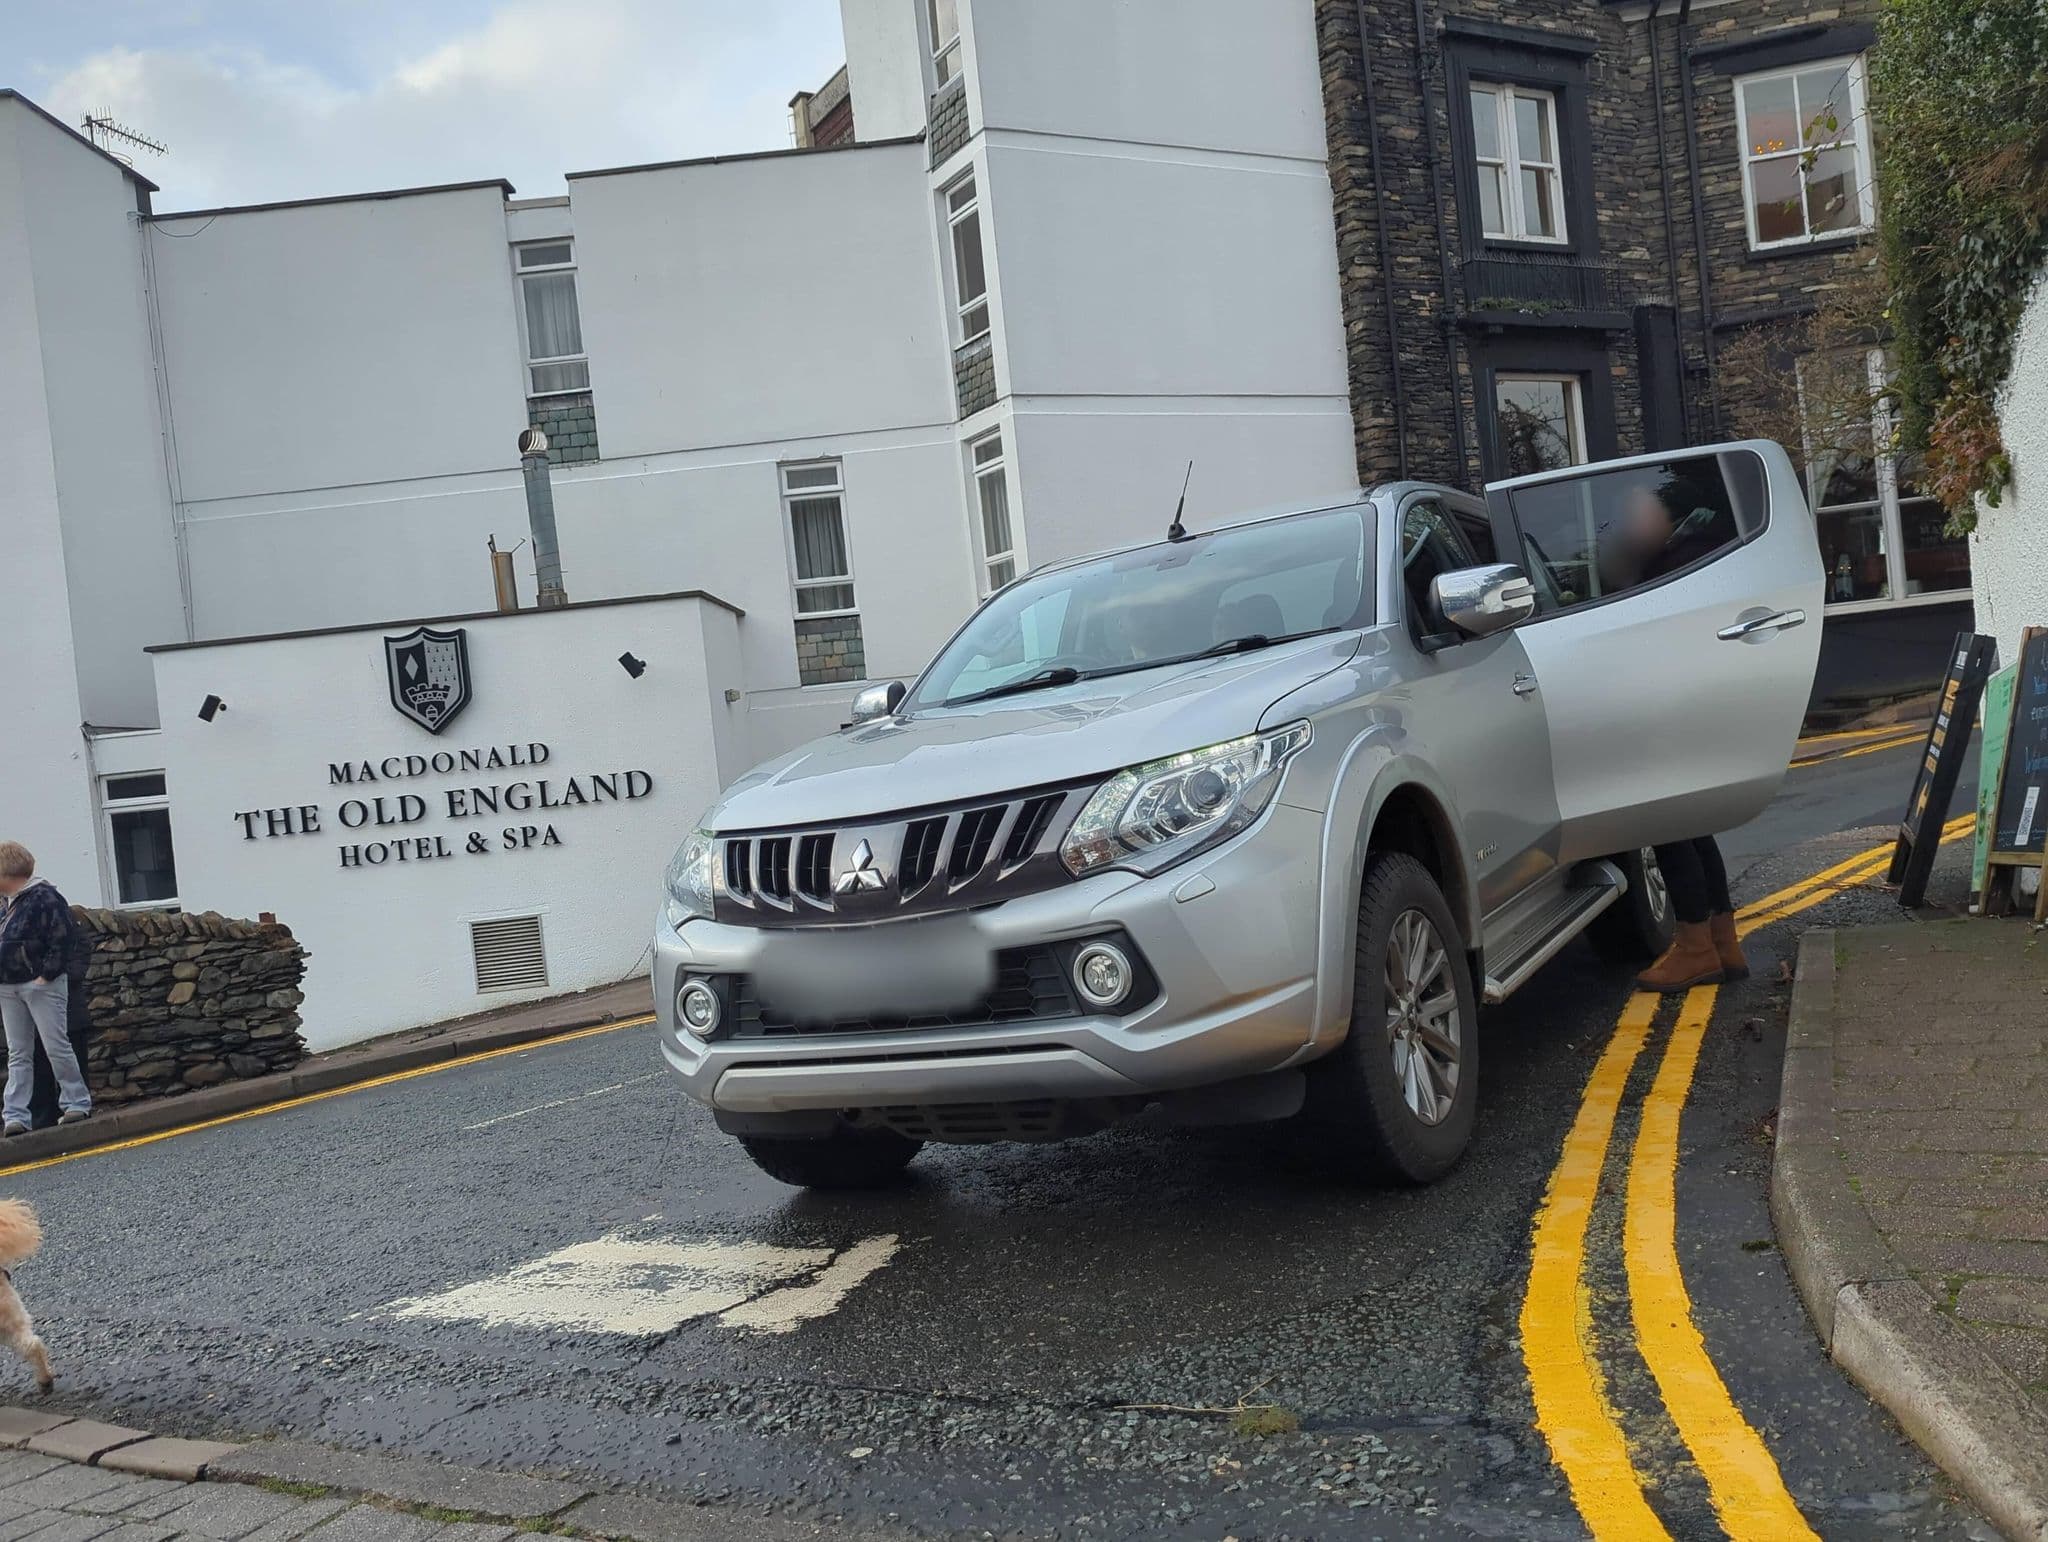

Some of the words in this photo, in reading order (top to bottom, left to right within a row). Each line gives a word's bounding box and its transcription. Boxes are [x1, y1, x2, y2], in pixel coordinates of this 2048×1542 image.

[328, 742, 550, 785] MACDONALD
[234, 804, 322, 841] THE
[338, 794, 427, 828] OLD
[444, 769, 654, 819] ENGLAND
[339, 835, 452, 868] HOTEL
[465, 831, 490, 855] &
[502, 824, 562, 850] SPA
